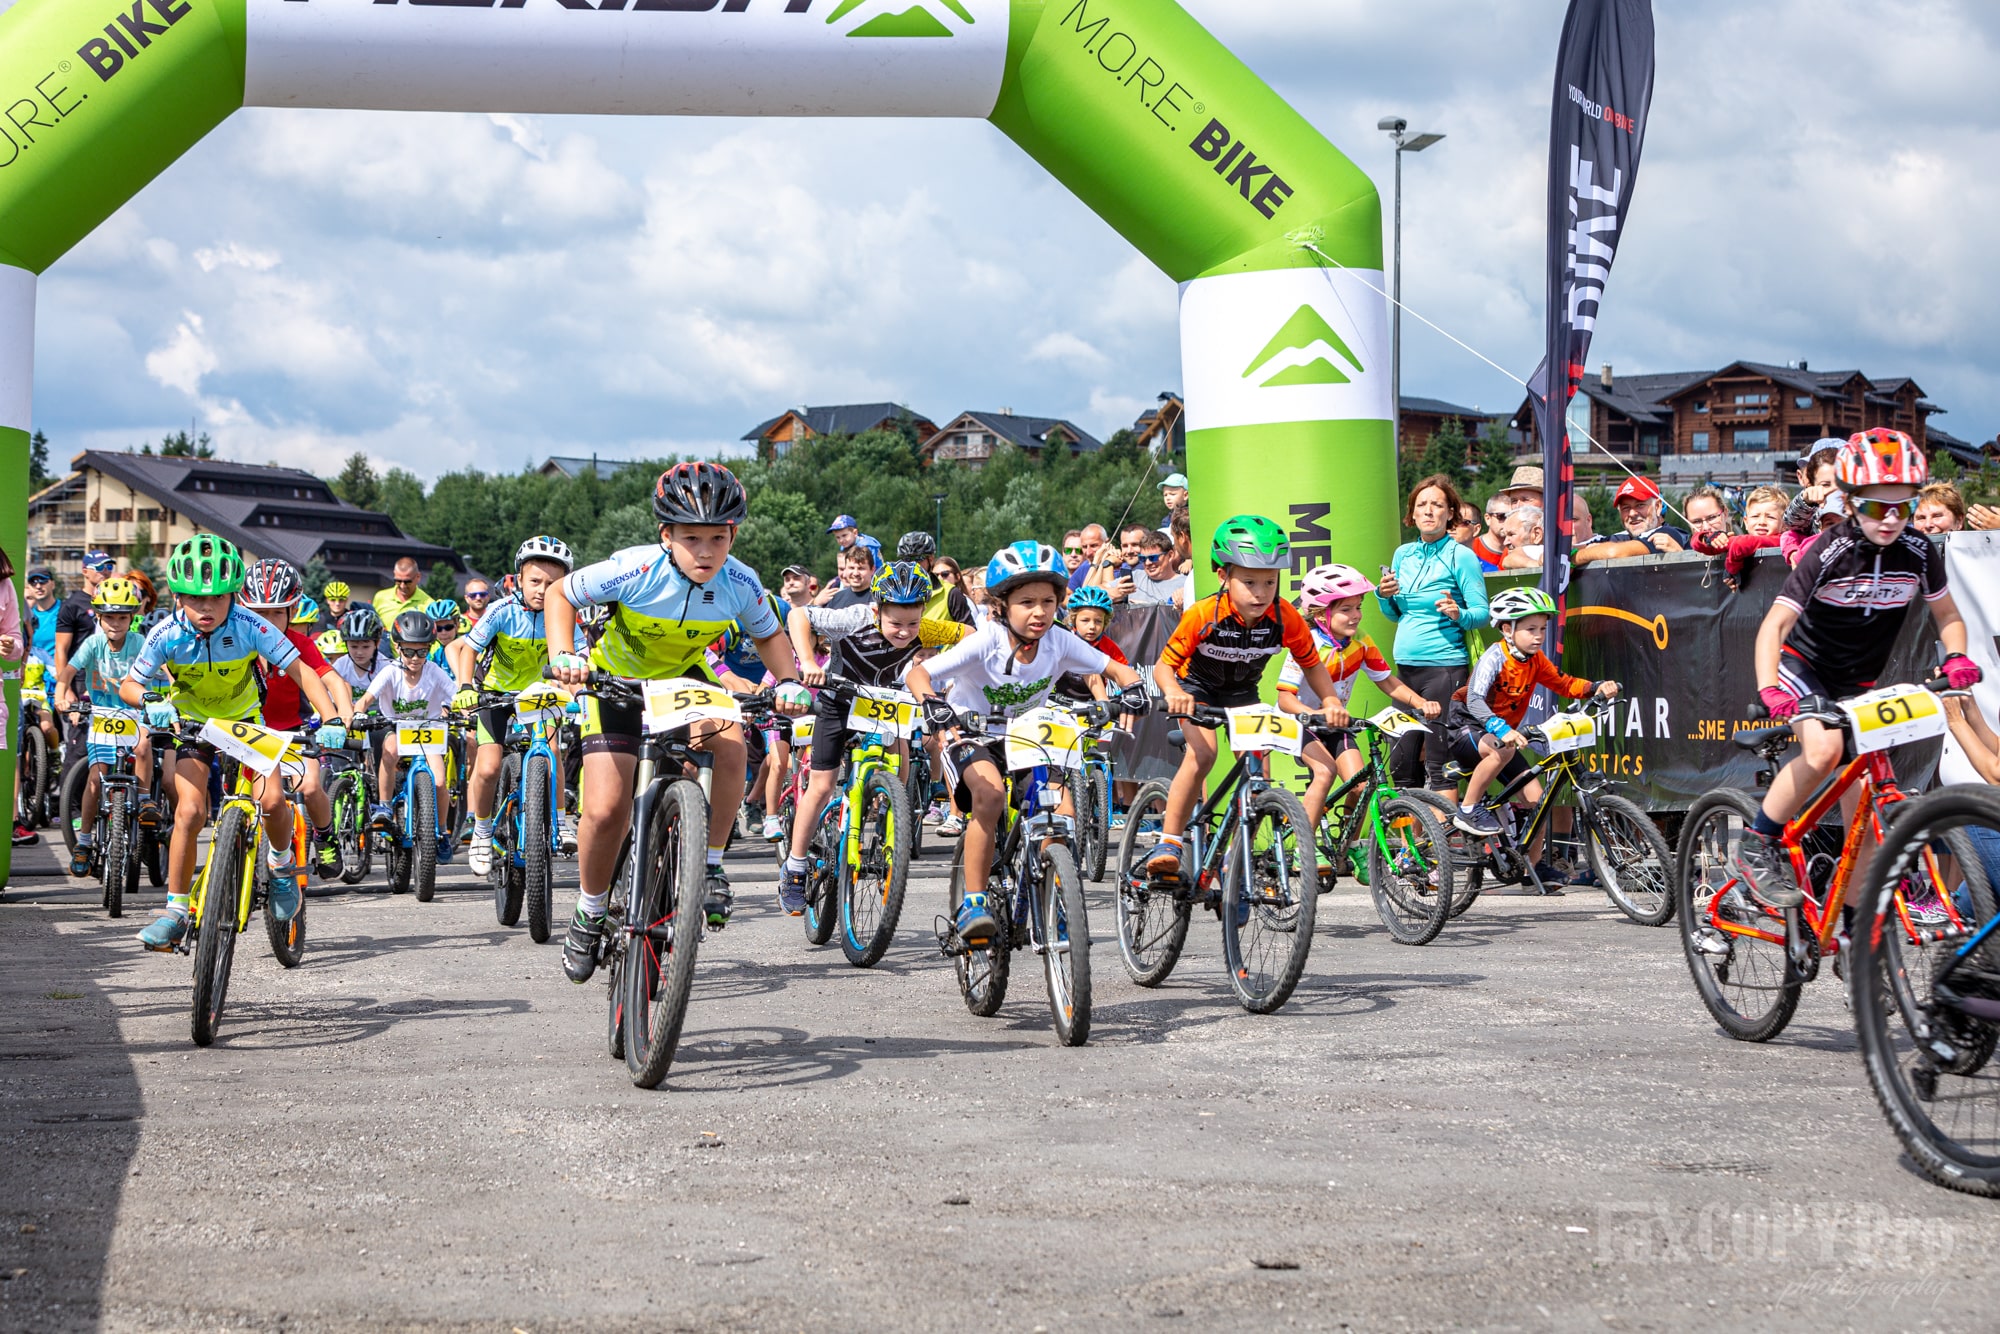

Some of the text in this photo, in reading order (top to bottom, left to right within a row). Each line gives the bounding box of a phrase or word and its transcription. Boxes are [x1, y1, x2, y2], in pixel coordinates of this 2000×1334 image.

[77, 0, 192, 82] BIKE
[1189, 117, 1294, 220] BIKE
[601, 568, 641, 592] SLOVENSKA
[728, 568, 762, 599] SLOVENSKA
[1844, 588, 1891, 600] CRAFT
[232, 611, 261, 629] OVENSKA
[486, 601, 509, 624] SLOVENSKA
[148, 620, 178, 648] SLOVENSK
[1218, 630, 1242, 638] BMC
[674, 690, 712, 710] 53
[868, 701, 897, 720] 59
[1877, 697, 1913, 724] 61
[103, 719, 126, 734] 69
[1251, 715, 1282, 734] 75
[1383, 713, 1410, 730] 76
[1574, 695, 1671, 739] MAR
[231, 722, 267, 745] 67
[411, 730, 432, 744] 23
[1038, 723, 1054, 745] 2
